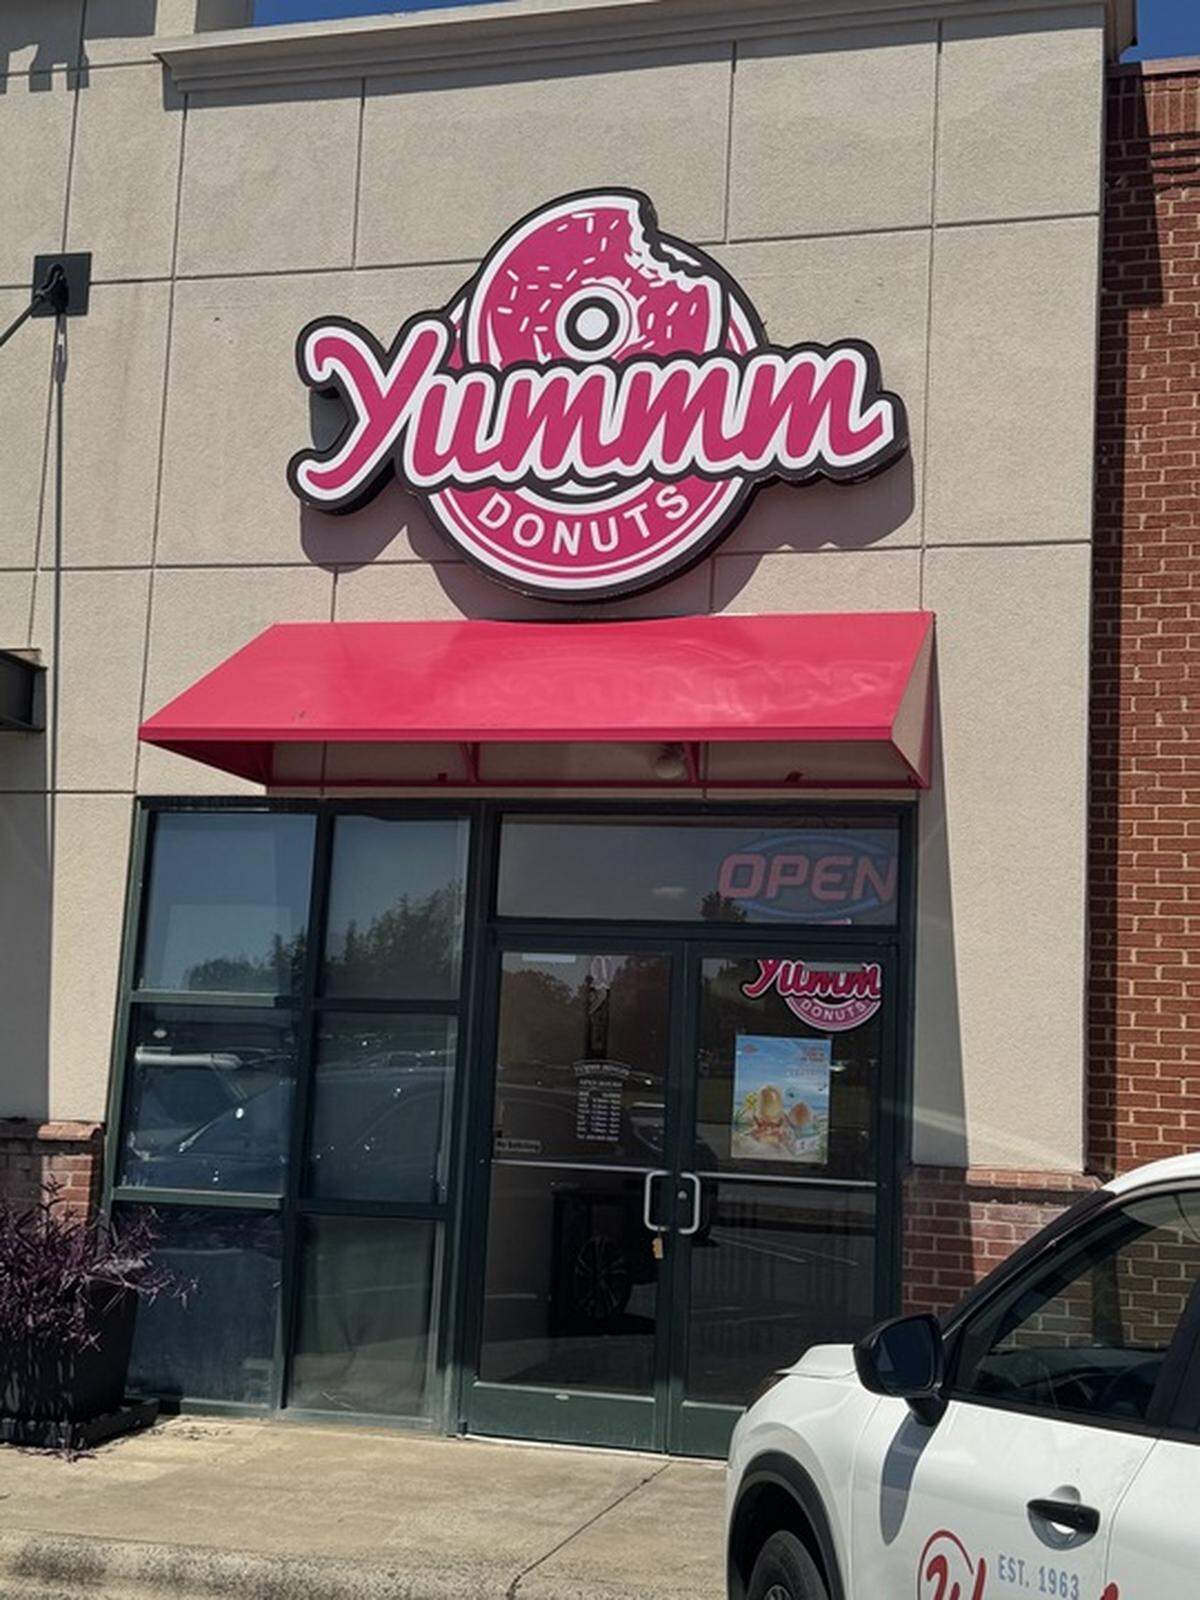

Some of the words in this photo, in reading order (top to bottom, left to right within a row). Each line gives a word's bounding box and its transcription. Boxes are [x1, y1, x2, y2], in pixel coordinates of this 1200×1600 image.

[298, 320, 894, 500] Yummm
[477, 483, 689, 557] DONUTS
[718, 853, 897, 902] OPEN
[800, 999, 867, 1021] DONUTS
[998, 1555, 1030, 1587] EST.
[1038, 1566, 1080, 1600] 1963
